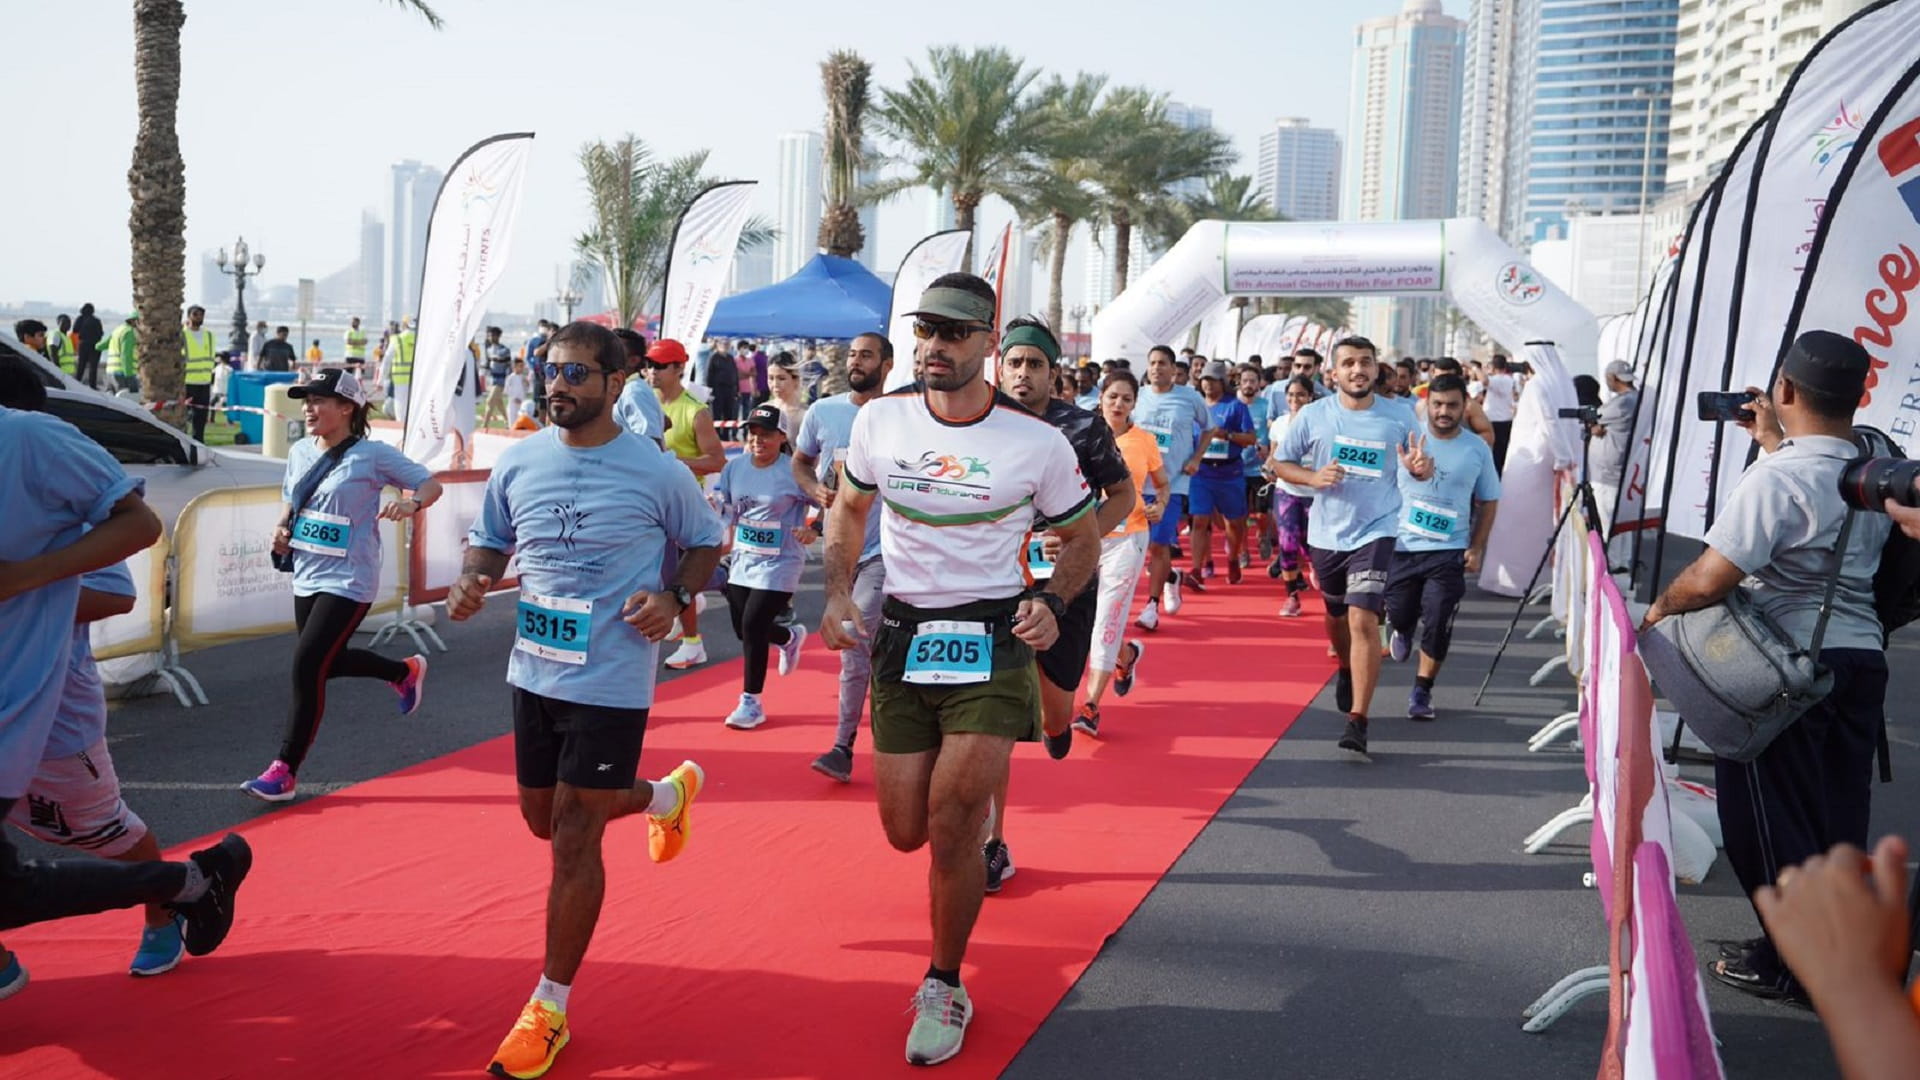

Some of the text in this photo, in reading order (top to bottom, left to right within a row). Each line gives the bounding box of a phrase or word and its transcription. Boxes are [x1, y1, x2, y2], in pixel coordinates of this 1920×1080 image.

[475, 227, 491, 293] PATIENTS
[1256, 280, 1297, 289] Annual
[1300, 279, 1341, 289] Charity
[1345, 279, 1370, 289] Run
[1373, 278, 1394, 288] For
[1397, 276, 1433, 286] FOAP
[1338, 447, 1378, 465] 5242
[1414, 511, 1450, 531] 5129
[301, 522, 341, 543] 5263
[742, 528, 775, 544] 5262
[524, 610, 578, 642] 5315
[916, 639, 980, 664] 5205
